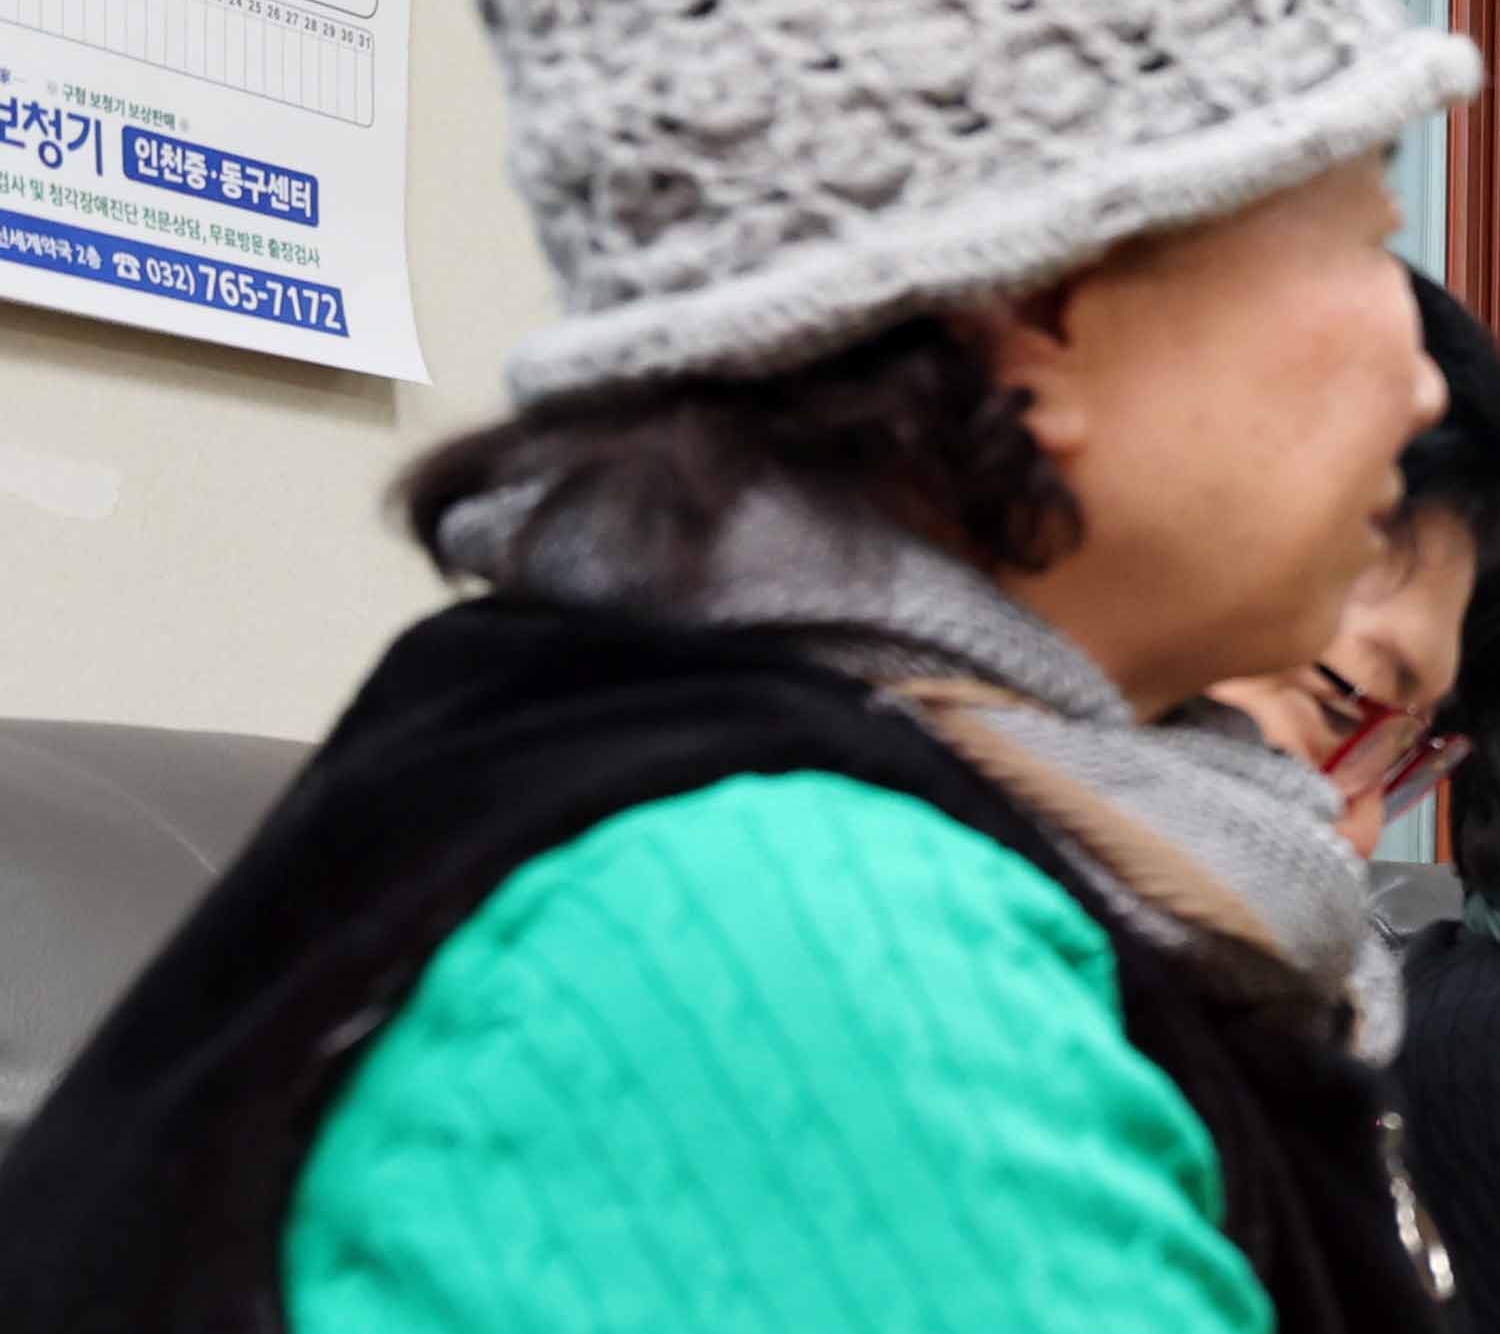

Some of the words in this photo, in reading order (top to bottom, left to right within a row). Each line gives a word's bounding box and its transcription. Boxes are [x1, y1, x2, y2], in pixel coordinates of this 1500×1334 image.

[267, 3, 281, 21] 26
[286, 10, 299, 26] 27
[304, 16, 318, 32] 28
[322, 22, 336, 38] 29
[341, 27, 354, 44] 30
[358, 33, 371, 50] 31
[29, 179, 44, 201] 및
[210, 222, 266, 257] 무료방문
[268, 238, 321, 271] 출장검사
[75, 244, 104, 271] 2층
[146, 256, 197, 297] 032)
[198, 264, 343, 330] 765-7172
